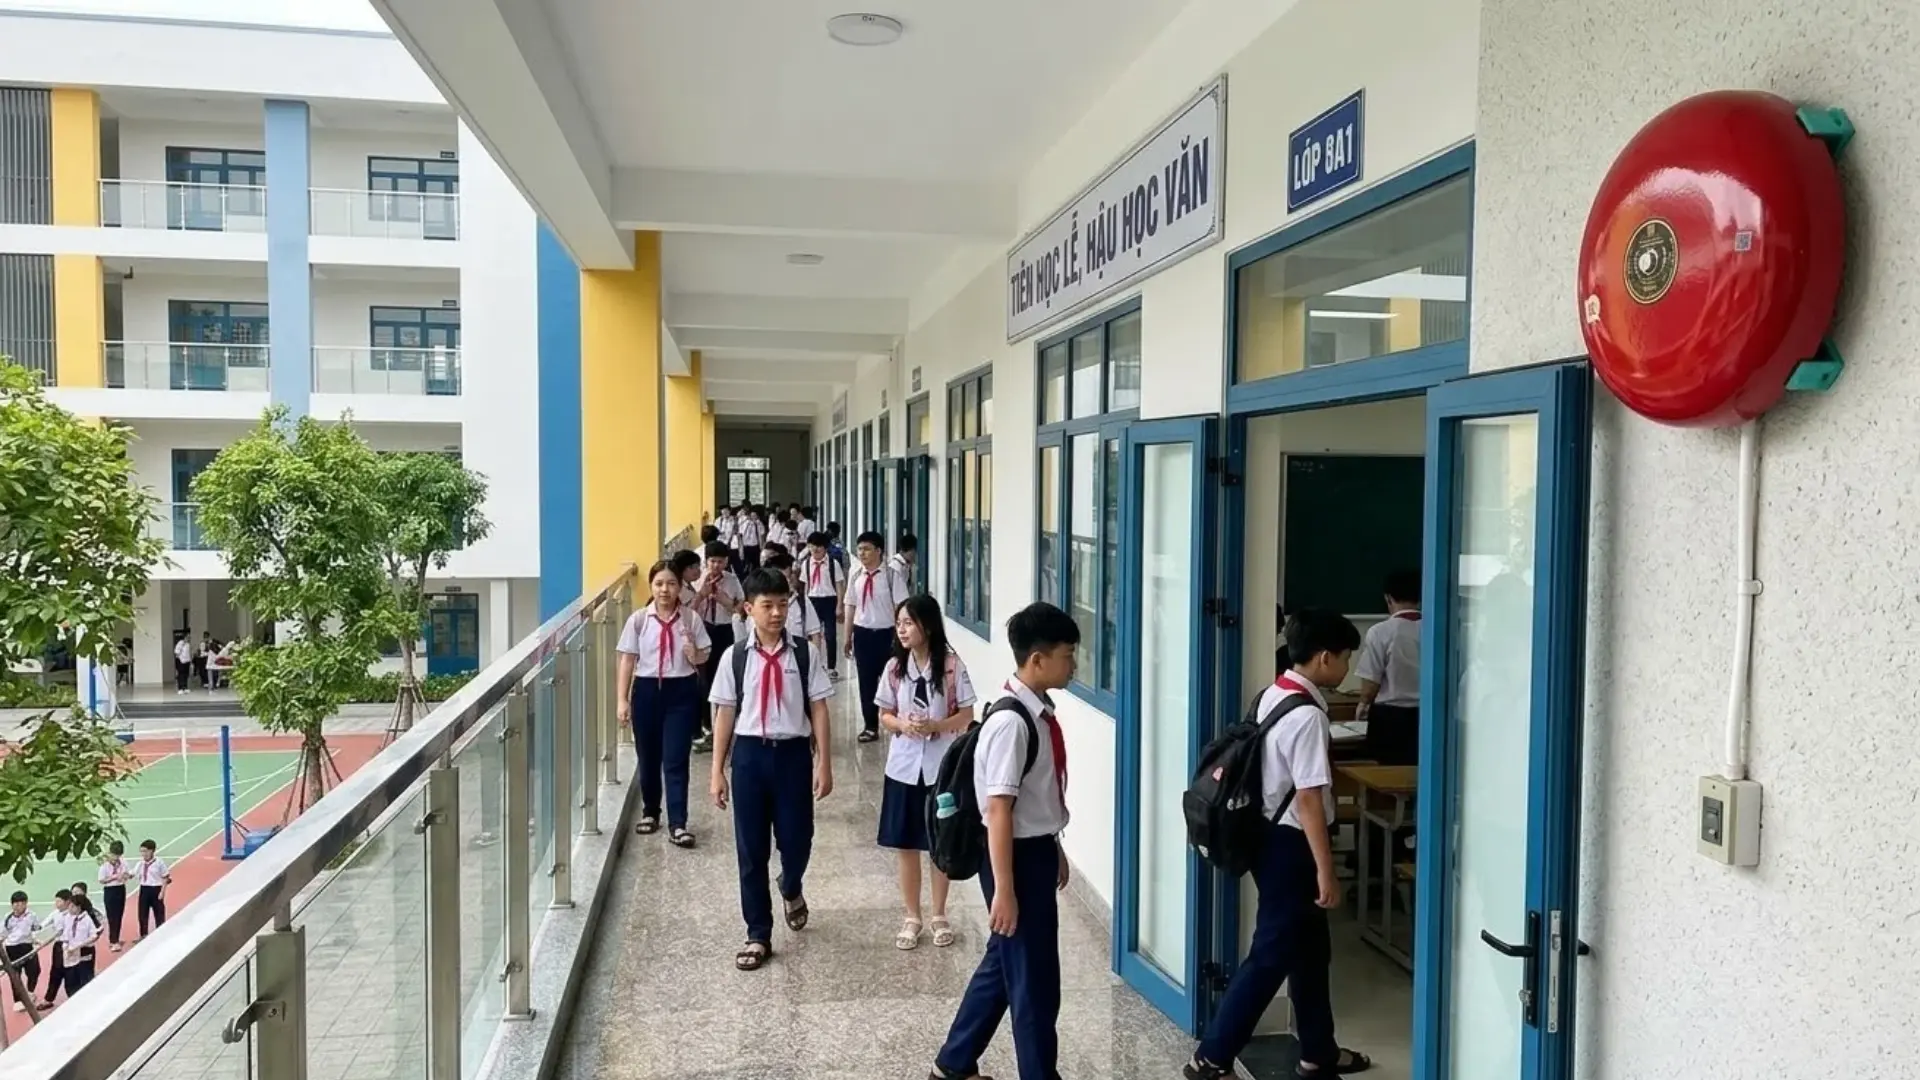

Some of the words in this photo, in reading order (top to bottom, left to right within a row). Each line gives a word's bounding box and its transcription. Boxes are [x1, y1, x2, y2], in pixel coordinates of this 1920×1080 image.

[1036, 246, 1060, 309] HỌC
[1086, 201, 1117, 279] HẬU
[1122, 175, 1159, 258] HỌC
[1164, 134, 1209, 226] VĂN
